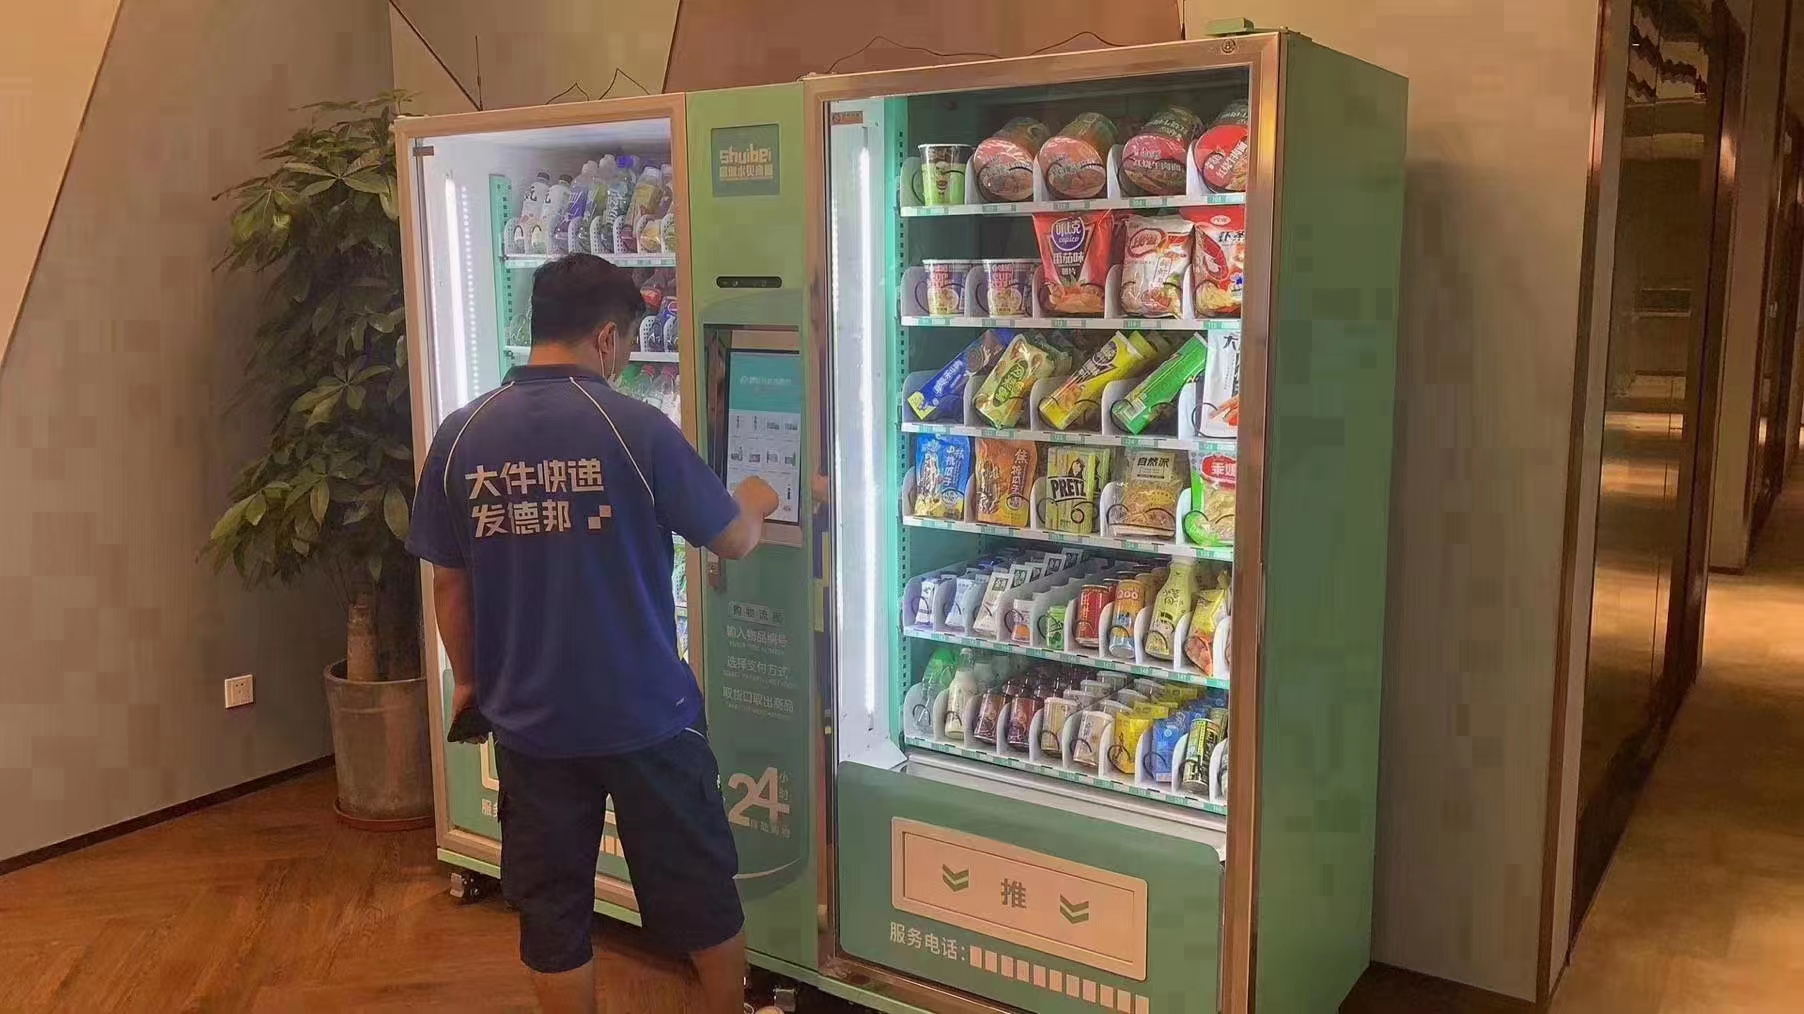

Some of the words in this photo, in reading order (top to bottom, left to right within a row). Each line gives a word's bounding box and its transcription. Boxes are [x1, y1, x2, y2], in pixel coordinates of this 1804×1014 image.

[1053, 251, 1084, 265] 番茄味
[1137, 456, 1170, 468] 自然派
[465, 458, 604, 500] 大件快递
[1050, 478, 1087, 499] PRETZ
[472, 499, 571, 538] 发德邦
[727, 655, 788, 678] 选择支付方式
[728, 766, 790, 827] 24
[1001, 878, 1026, 909] 推
[889, 921, 967, 962] 服务电话:
